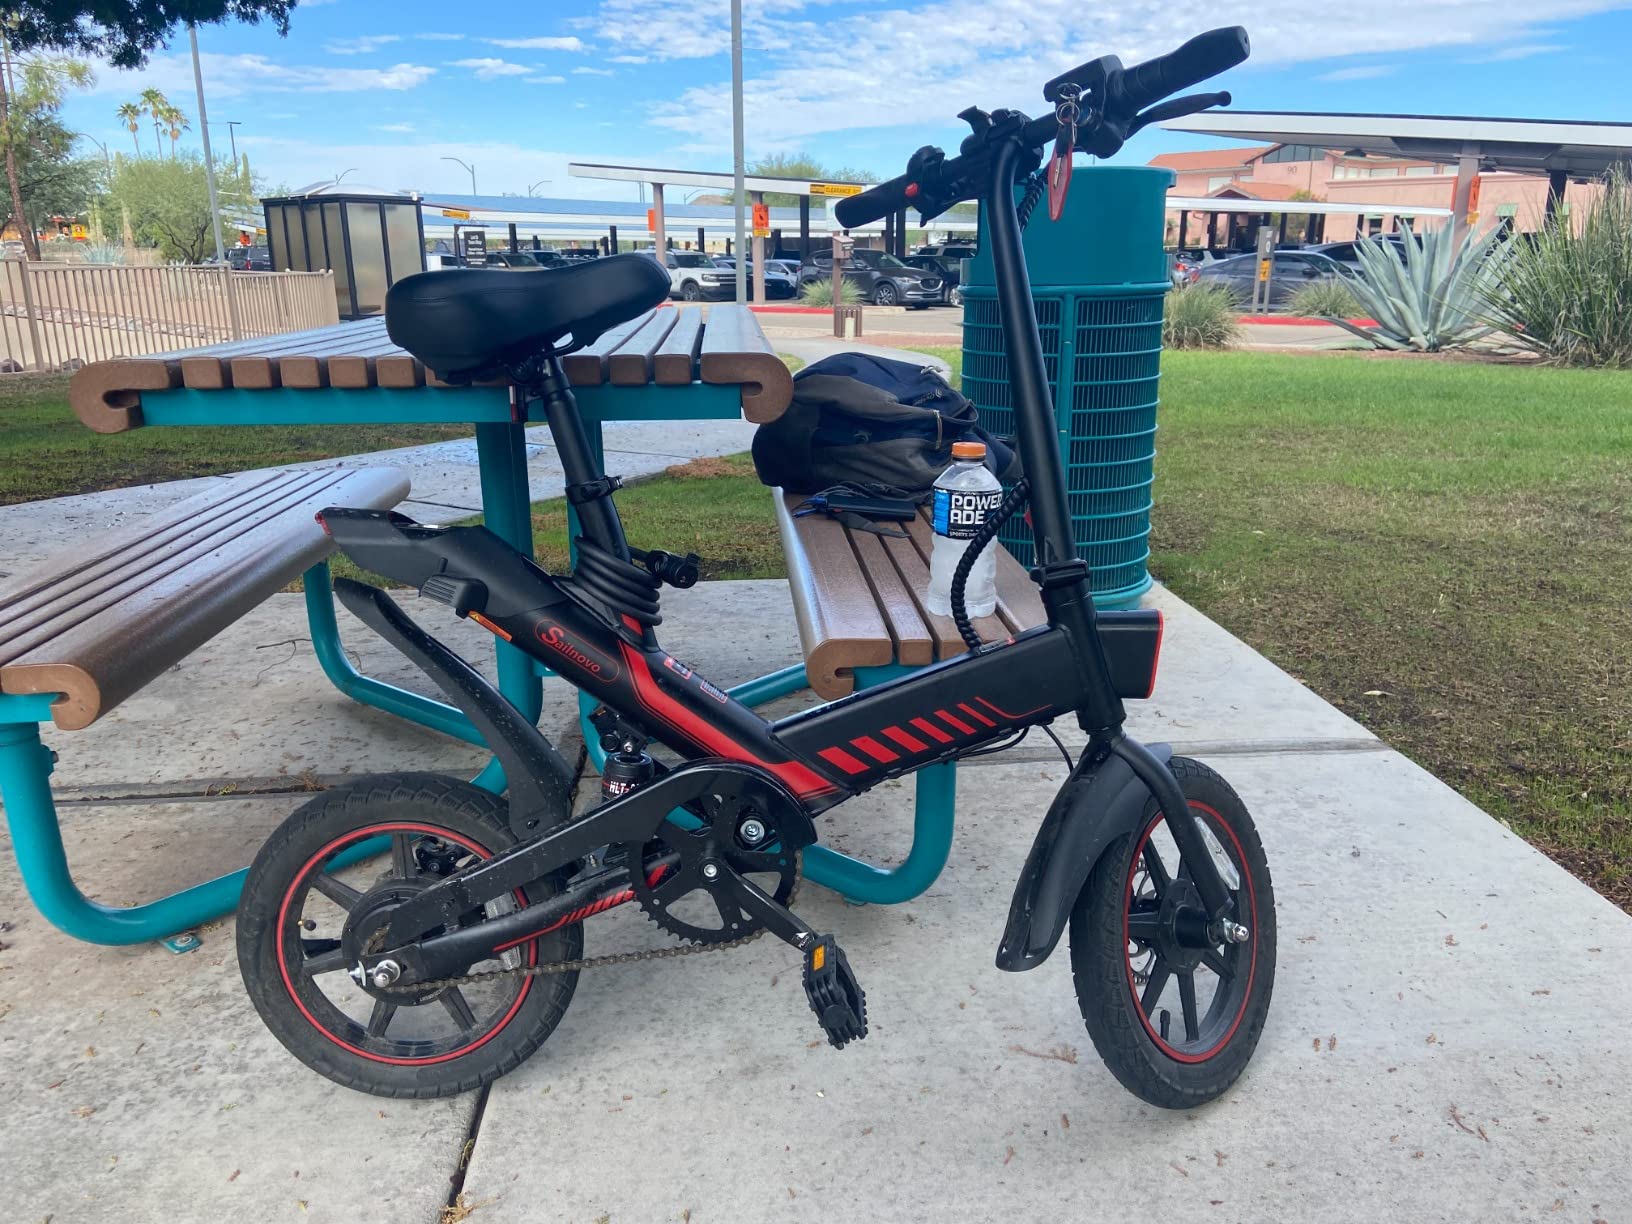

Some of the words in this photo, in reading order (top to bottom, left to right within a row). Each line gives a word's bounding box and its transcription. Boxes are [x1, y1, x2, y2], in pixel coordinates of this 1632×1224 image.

[951, 493, 1003, 510] POWER
[950, 509, 985, 525] ADE
[541, 626, 601, 673] Sailnovo
